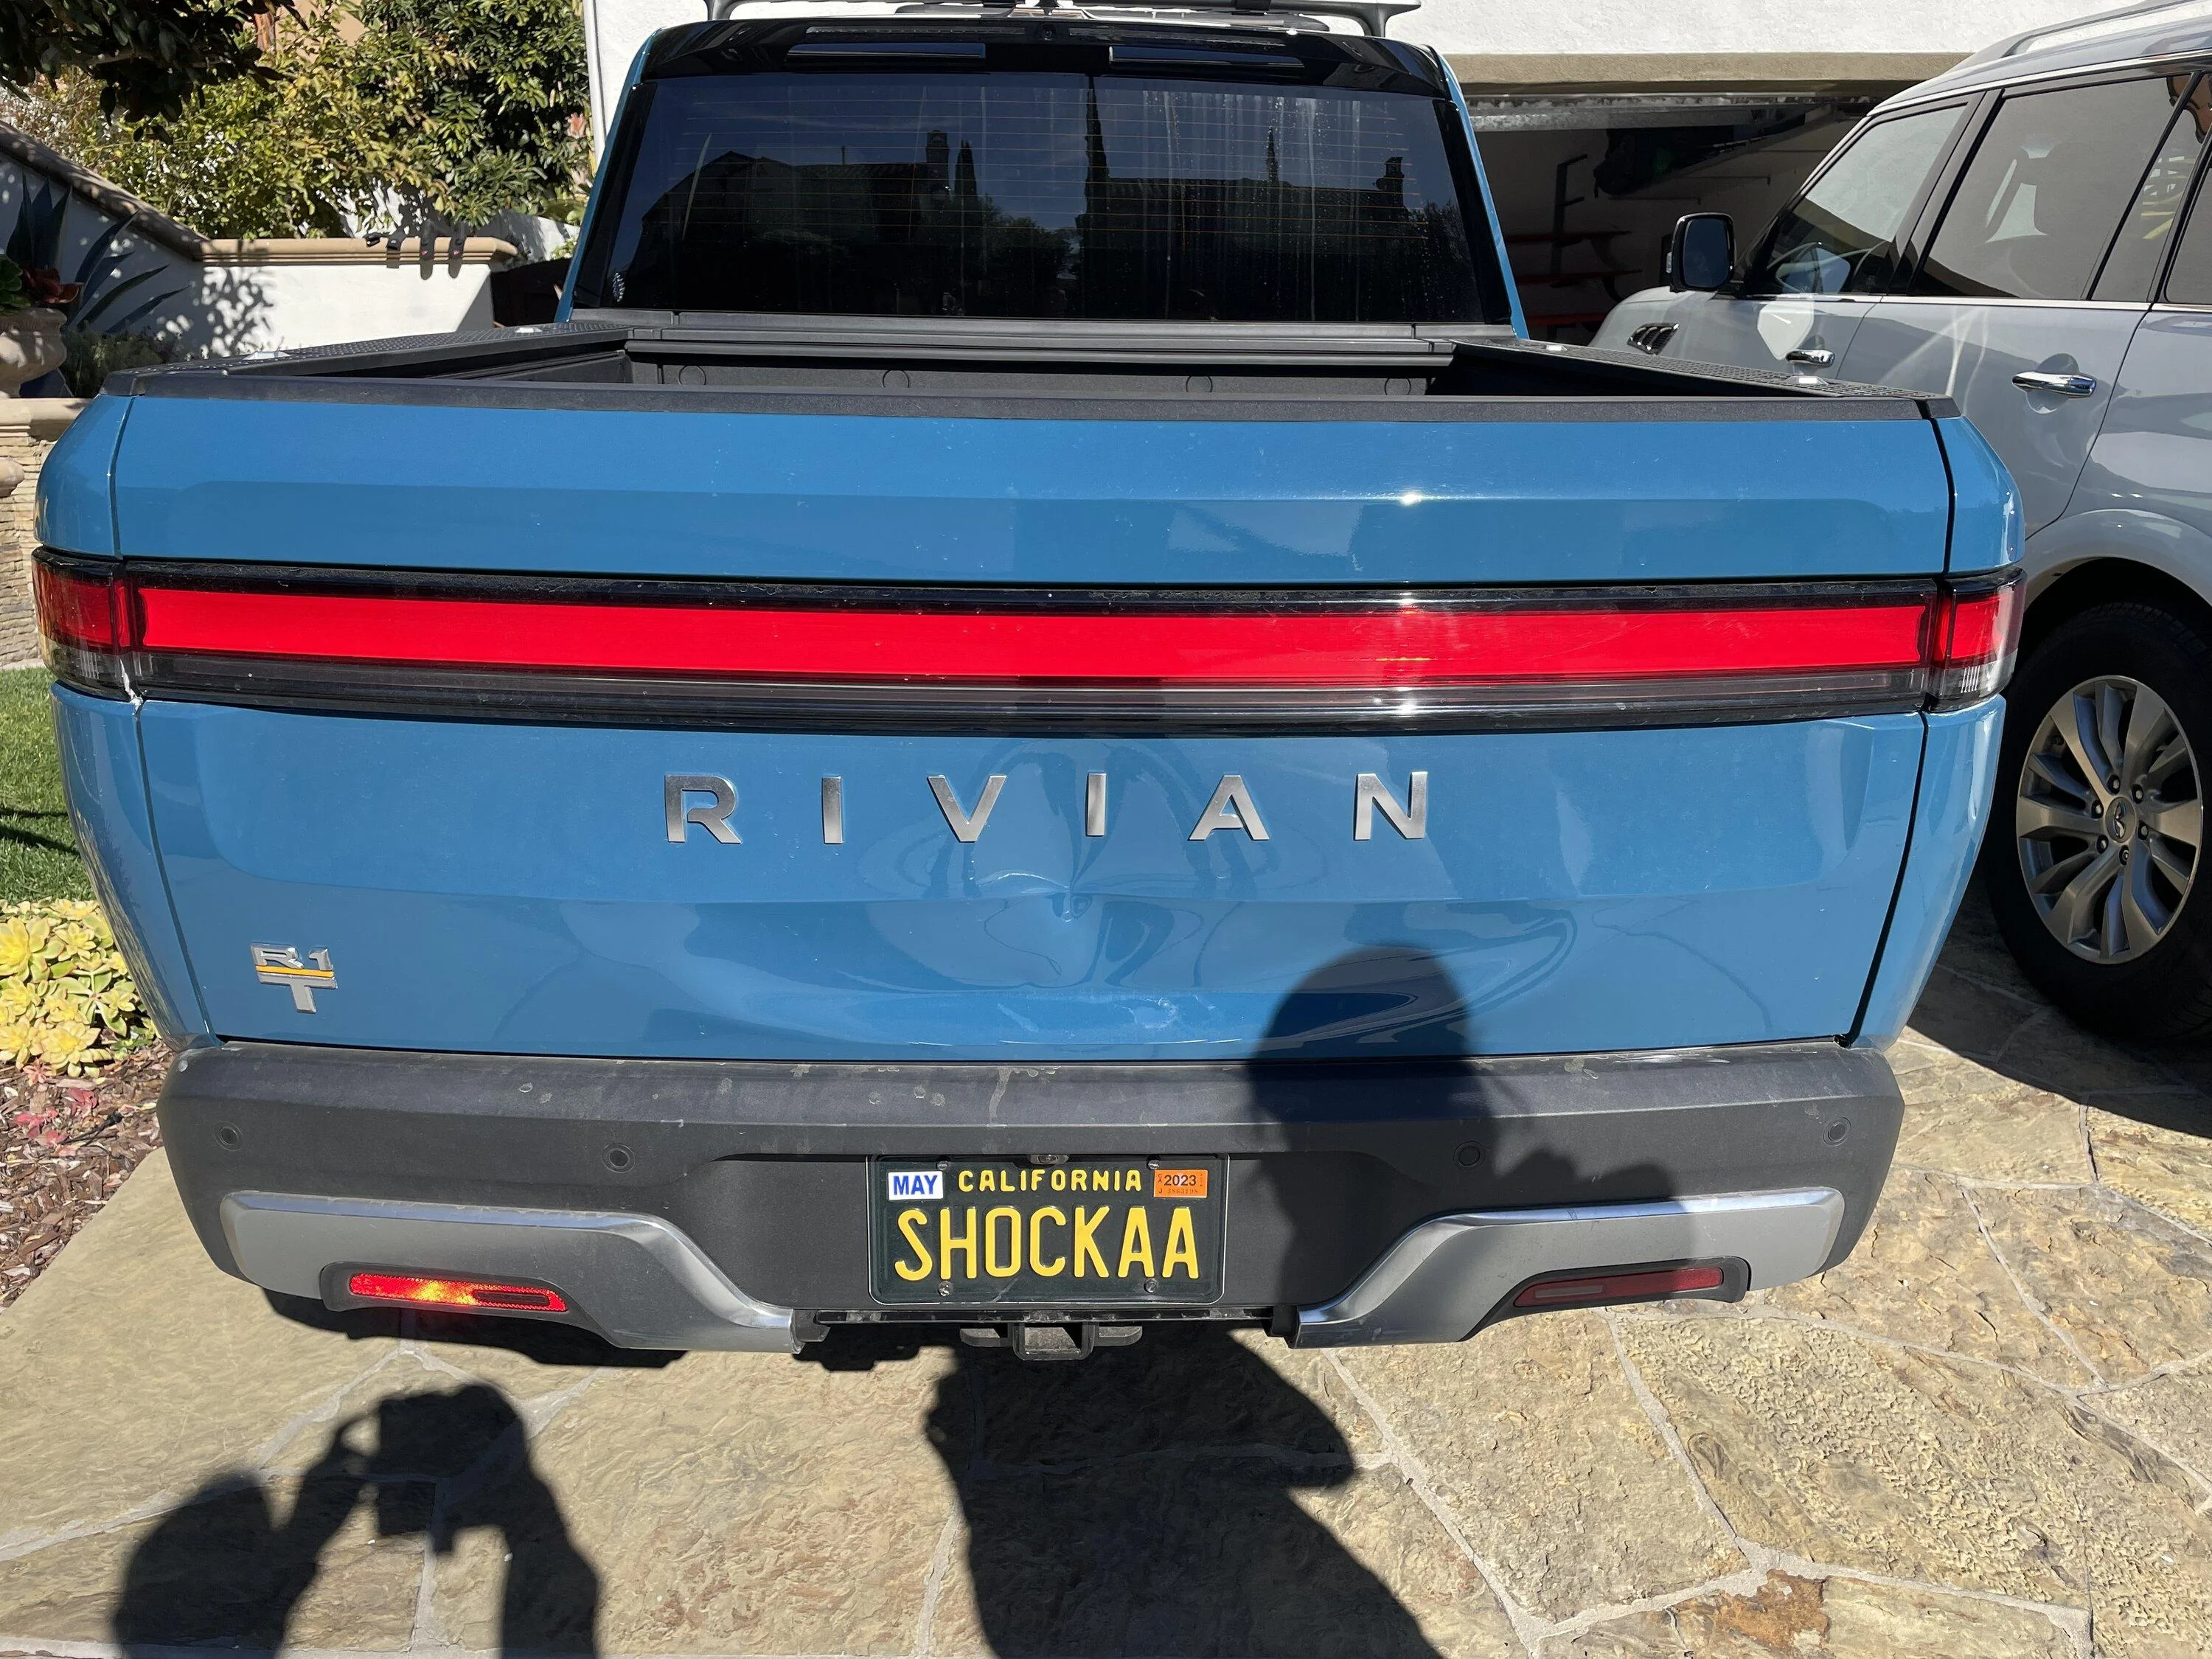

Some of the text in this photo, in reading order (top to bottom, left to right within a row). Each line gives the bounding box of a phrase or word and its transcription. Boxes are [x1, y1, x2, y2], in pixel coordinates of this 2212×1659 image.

[665, 771, 1427, 844] RIVIAN
[894, 1175, 938, 1195] MAY
[958, 1169, 1142, 1192] CALIFORNIA
[1164, 1175, 1196, 1186] 2023
[894, 1207, 1200, 1281] SHOCKAA
